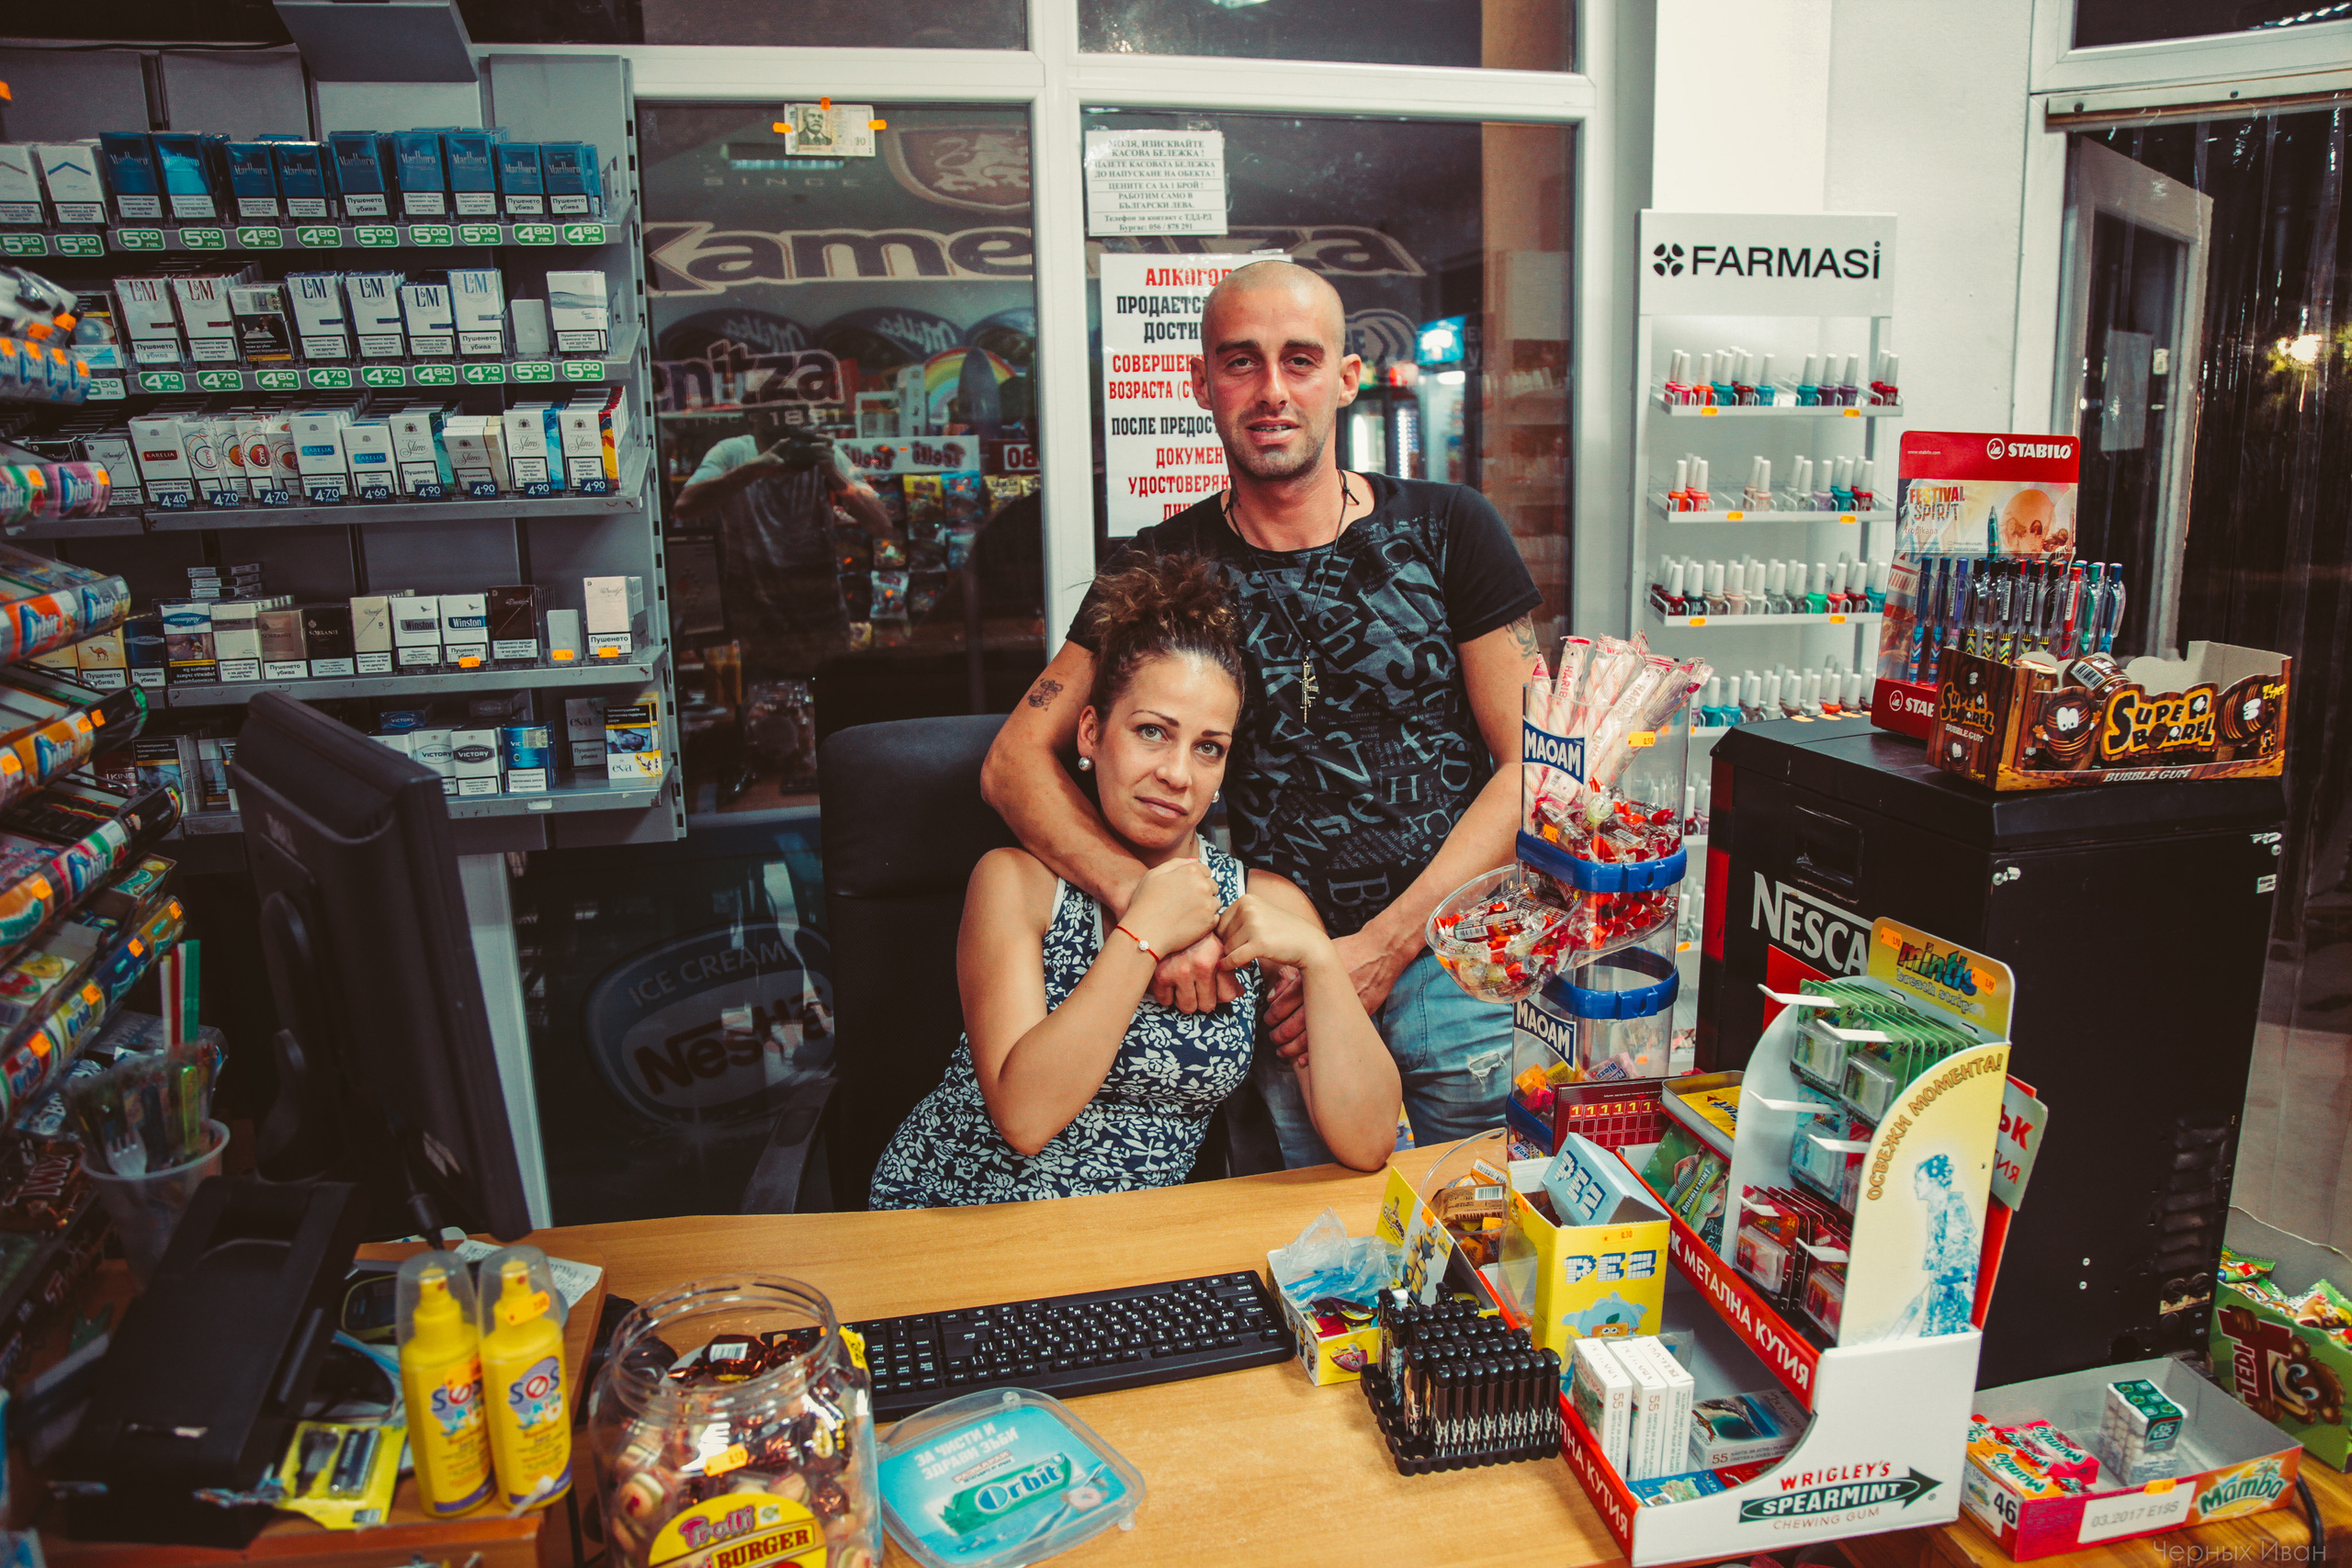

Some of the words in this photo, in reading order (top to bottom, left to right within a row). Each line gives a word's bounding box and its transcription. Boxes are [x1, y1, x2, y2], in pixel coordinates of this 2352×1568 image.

[1142, 140, 1204, 148] ИЗИСКВАЙТЕ
[1177, 181, 1199, 189] БРОЙ
[1116, 296, 1206, 317] ПРОДАЕТС
[1144, 322, 1202, 344] ДОСТИ
[1109, 381, 1173, 399] ВОЗРАСТА
[1112, 417, 1156, 435] ПОСЛЕ
[1160, 416, 1216, 437] ПРЕДОС
[145, 451, 176, 459] KARELIA
[1157, 446, 1224, 468] ДОКУМЕН
[2008, 443, 2072, 459] STABILO
[1909, 486, 1965, 503] FESTIVAL
[1914, 503, 1959, 521] SPIRIT
[1905, 525, 1939, 535] tropikana
[405, 620, 437, 630] Winston
[452, 617, 483, 628] Winston
[591, 636, 628, 644] Пушенето
[1945, 723, 1969, 739] BUBBLE
[1968, 731, 1984, 743] GUM
[1524, 728, 1581, 778] MAOAM
[612, 763, 633, 773] eva
[2103, 770, 2158, 783] BUBBLE
[2158, 768, 2192, 780] GUM
[628, 970, 677, 1009] ICE
[679, 939, 788, 985] CREAM
[1896, 942, 1978, 997] mintis
[1896, 967, 1936, 997] breath
[1516, 999, 1571, 1060] MAOAM
[1866, 1114, 1912, 1201] ОСВЕЖИ
[1907, 1053, 2004, 1117] МОМЕНТА!
[1680, 1167, 1712, 1215] DOUBLEMINT
[1684, 1245, 1752, 1332] МЕТАЛНА
[1755, 1316, 1810, 1390] КУТИЯ
[2233, 1344, 2256, 1406] TEDI
[914, 1450, 936, 1468] ЗА
[934, 1429, 984, 1460] ЧИСТИ
[982, 1422, 997, 1436] И
[921, 1448, 980, 1481] ЗДРАВИ
[979, 1427, 1020, 1453] ЗЪБИ
[1712, 1453, 1728, 1464] 55
[977, 1465, 1063, 1510] Orbit
[1780, 1461, 1892, 1492] WRIGLEY'S
[1587, 1473, 1629, 1540] КУТИЯ
[1762, 1482, 1901, 1516] SPEARMINT
[2197, 1475, 2288, 1518] Mamba
[1773, 1512, 1840, 1530] CHEWING
[1845, 1506, 1880, 1523] GUM
[1994, 1492, 2017, 1526] 46
[2091, 1507, 2144, 1529] 03.2017
[717, 1529, 809, 1568] BURGER
